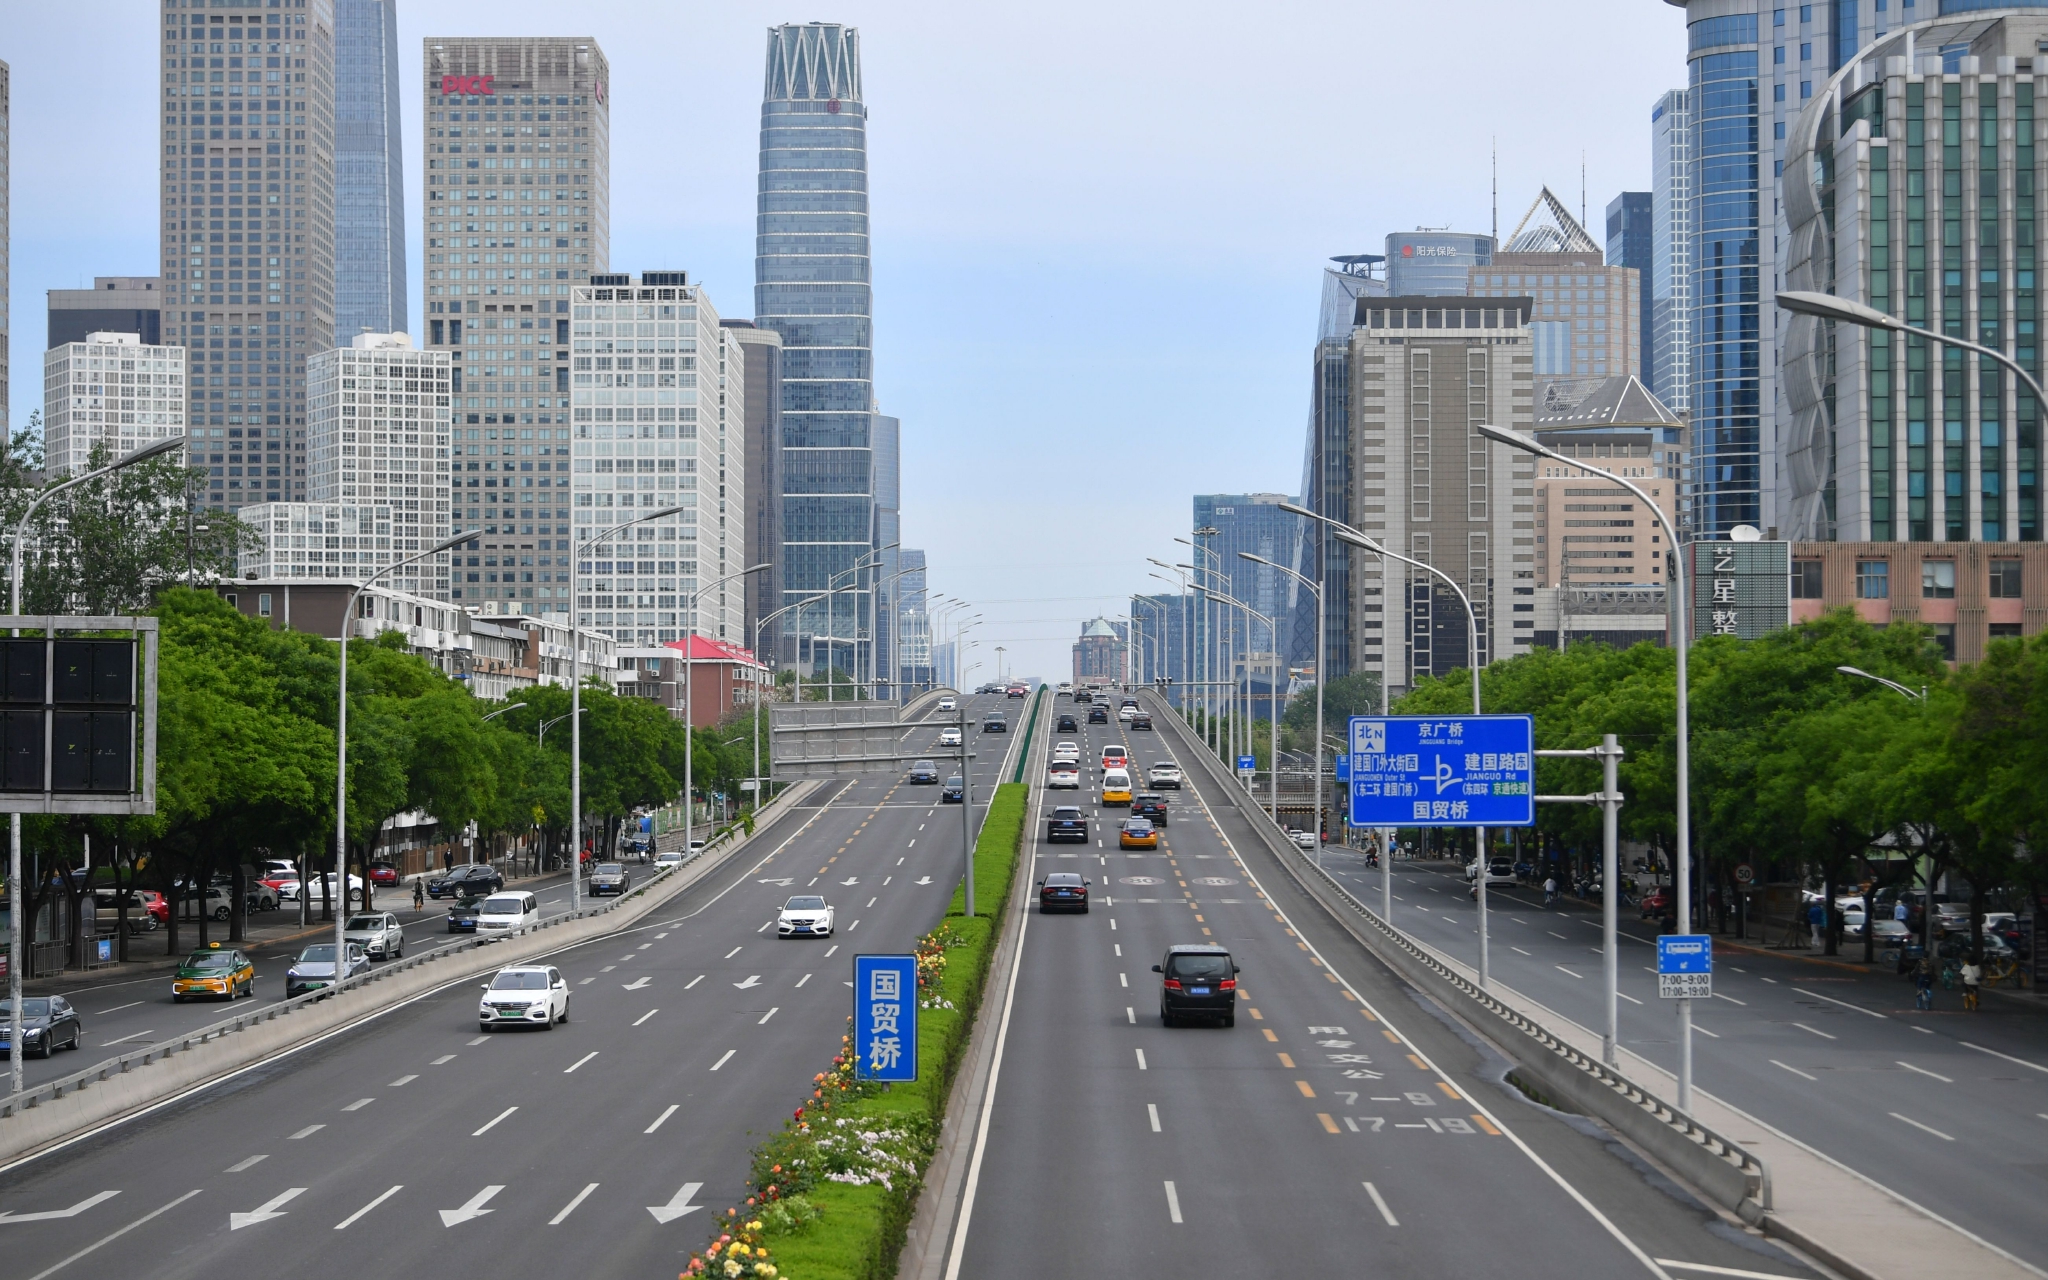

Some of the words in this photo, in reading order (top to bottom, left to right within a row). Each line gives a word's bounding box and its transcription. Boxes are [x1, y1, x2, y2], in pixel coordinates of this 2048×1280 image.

[442, 75, 494, 95] PICC
[1416, 245, 1457, 257] 阳光保险
[1711, 547, 1738, 635] 艺星整
[1358, 725, 1372, 739] 北
[1374, 729, 1383, 739] N
[1418, 722, 1464, 738] 京广桥
[1465, 772, 1502, 781] JIANGUO
[1505, 772, 1516, 780] Rd
[1413, 800, 1469, 820] 国贸桥
[1737, 869, 1750, 879] 50
[1661, 974, 1709, 985] 7:00-9:00
[1662, 986, 1709, 997] 17:00-19:00
[869, 969, 902, 1069] 国贸桥
